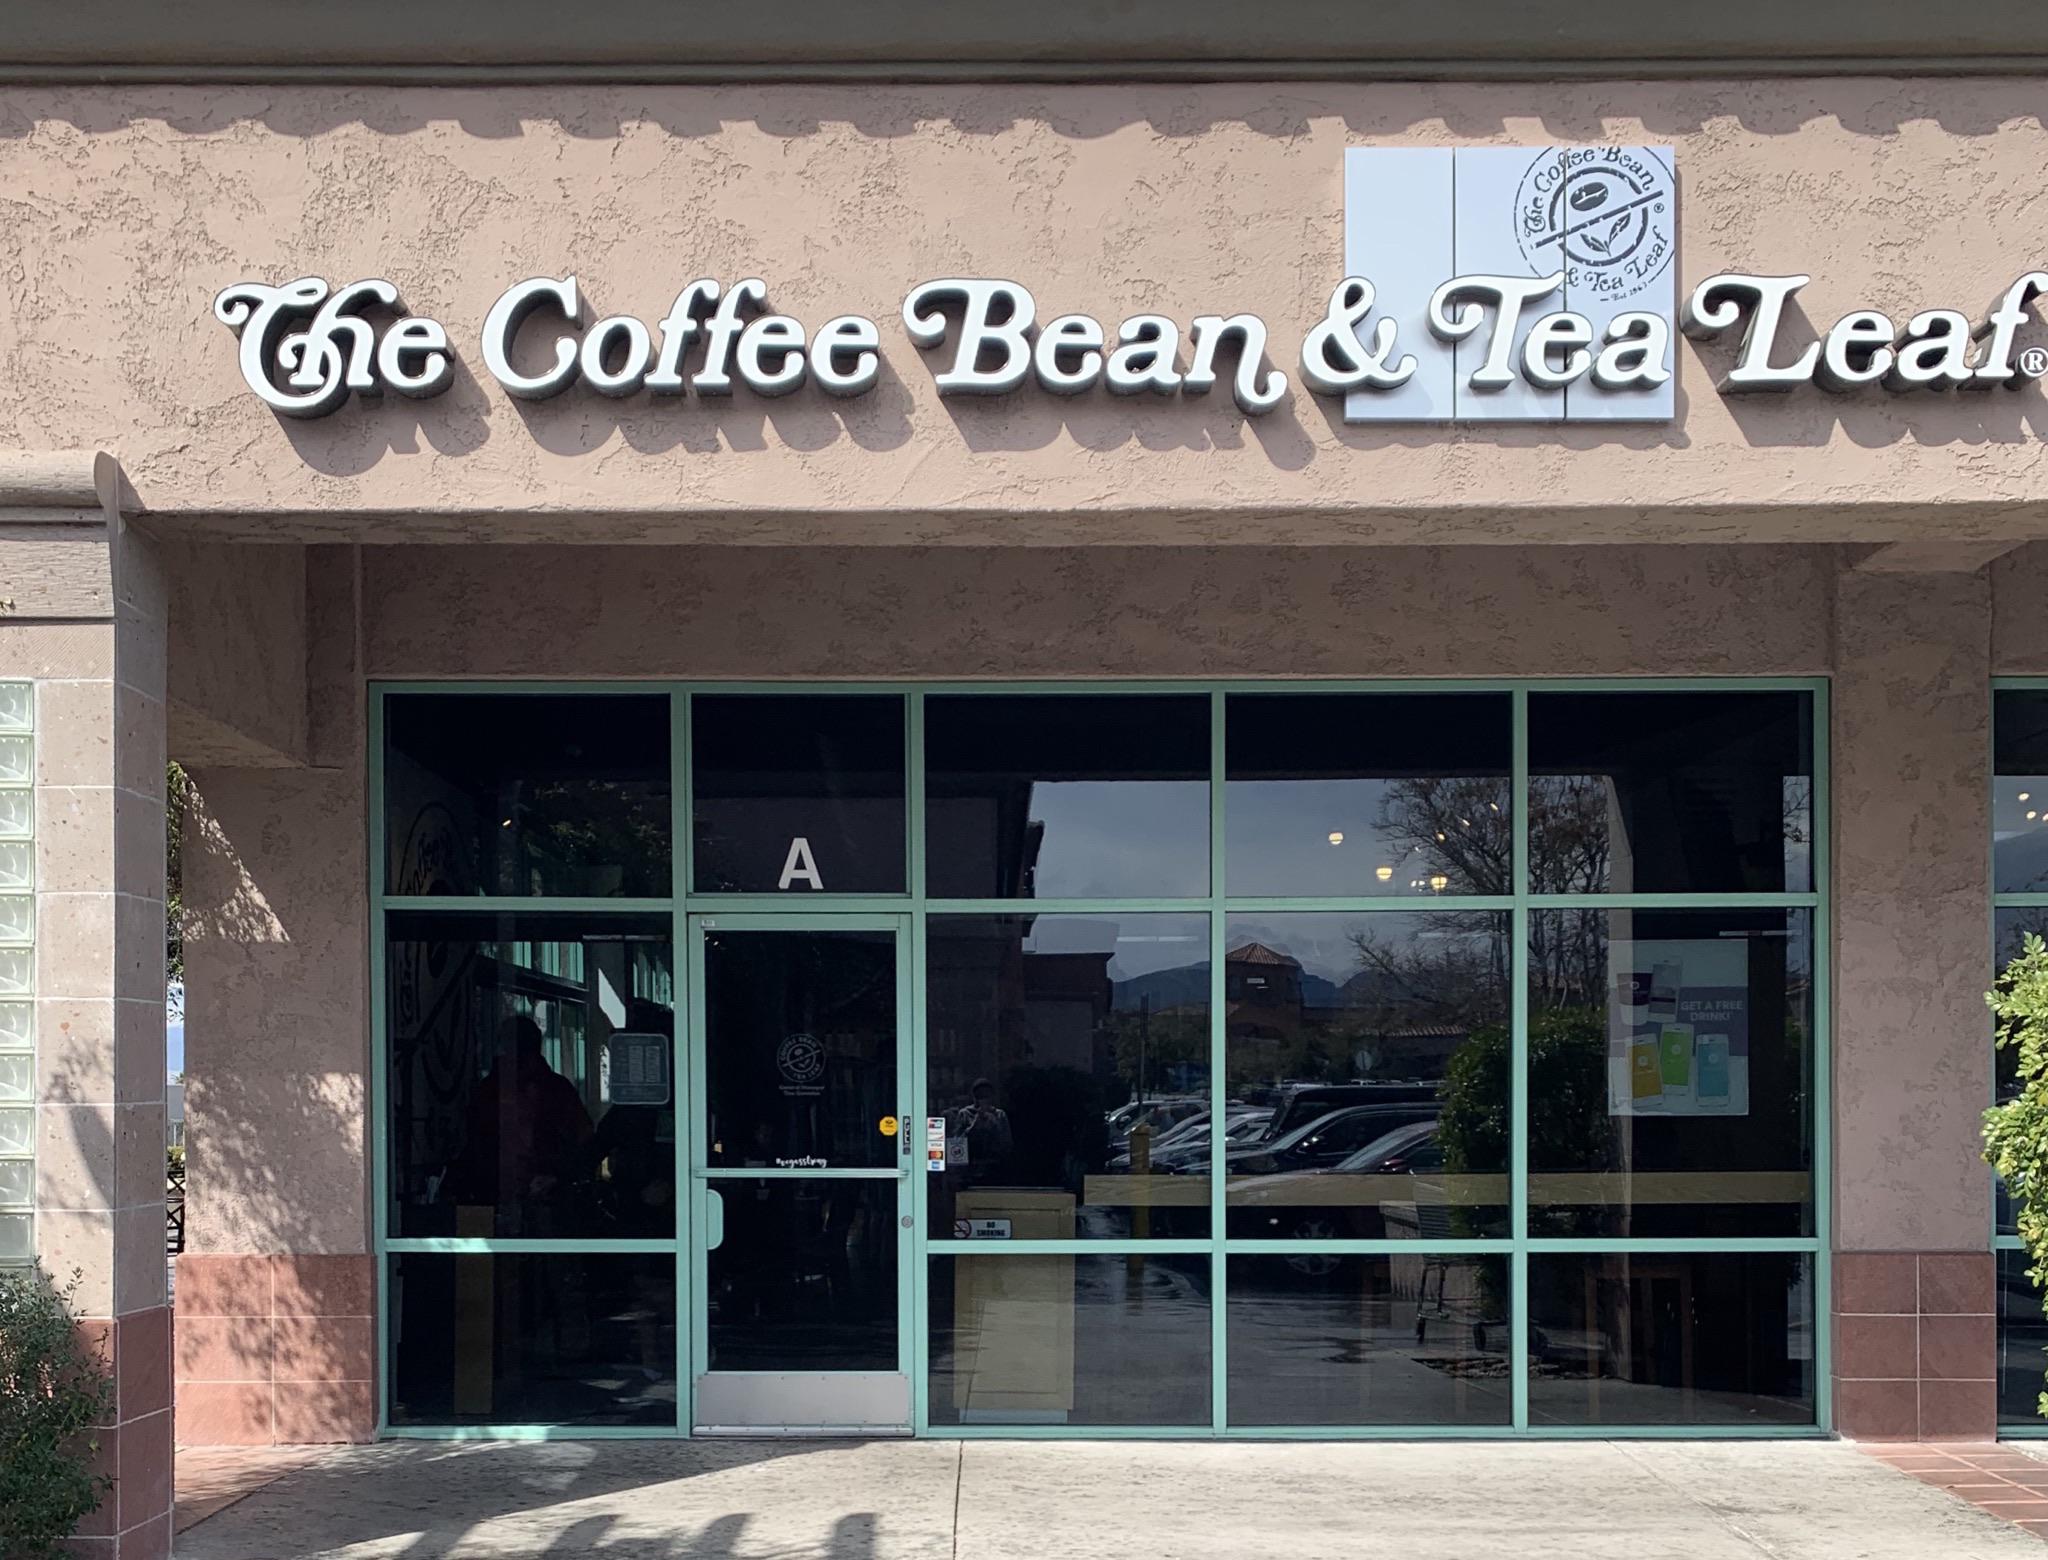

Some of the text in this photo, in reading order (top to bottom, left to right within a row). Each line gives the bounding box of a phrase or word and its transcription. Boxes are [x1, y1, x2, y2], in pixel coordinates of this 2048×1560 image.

[1524, 196, 1546, 238] The
[1598, 146, 1655, 191] Bean
[1584, 270, 1624, 292] Tea
[1624, 225, 1668, 279] Leaf
[214, 275, 452, 412] The
[481, 275, 883, 392] Coffee
[902, 277, 1288, 413] Bean
[1302, 275, 1418, 391] &
[1428, 270, 1671, 387] Tea
[1690, 271, 2048, 385] Leaf
[778, 837, 824, 889] A
[1680, 1000, 1744, 1010] GET A FREE
[976, 1229, 1006, 1237] SMOKING
